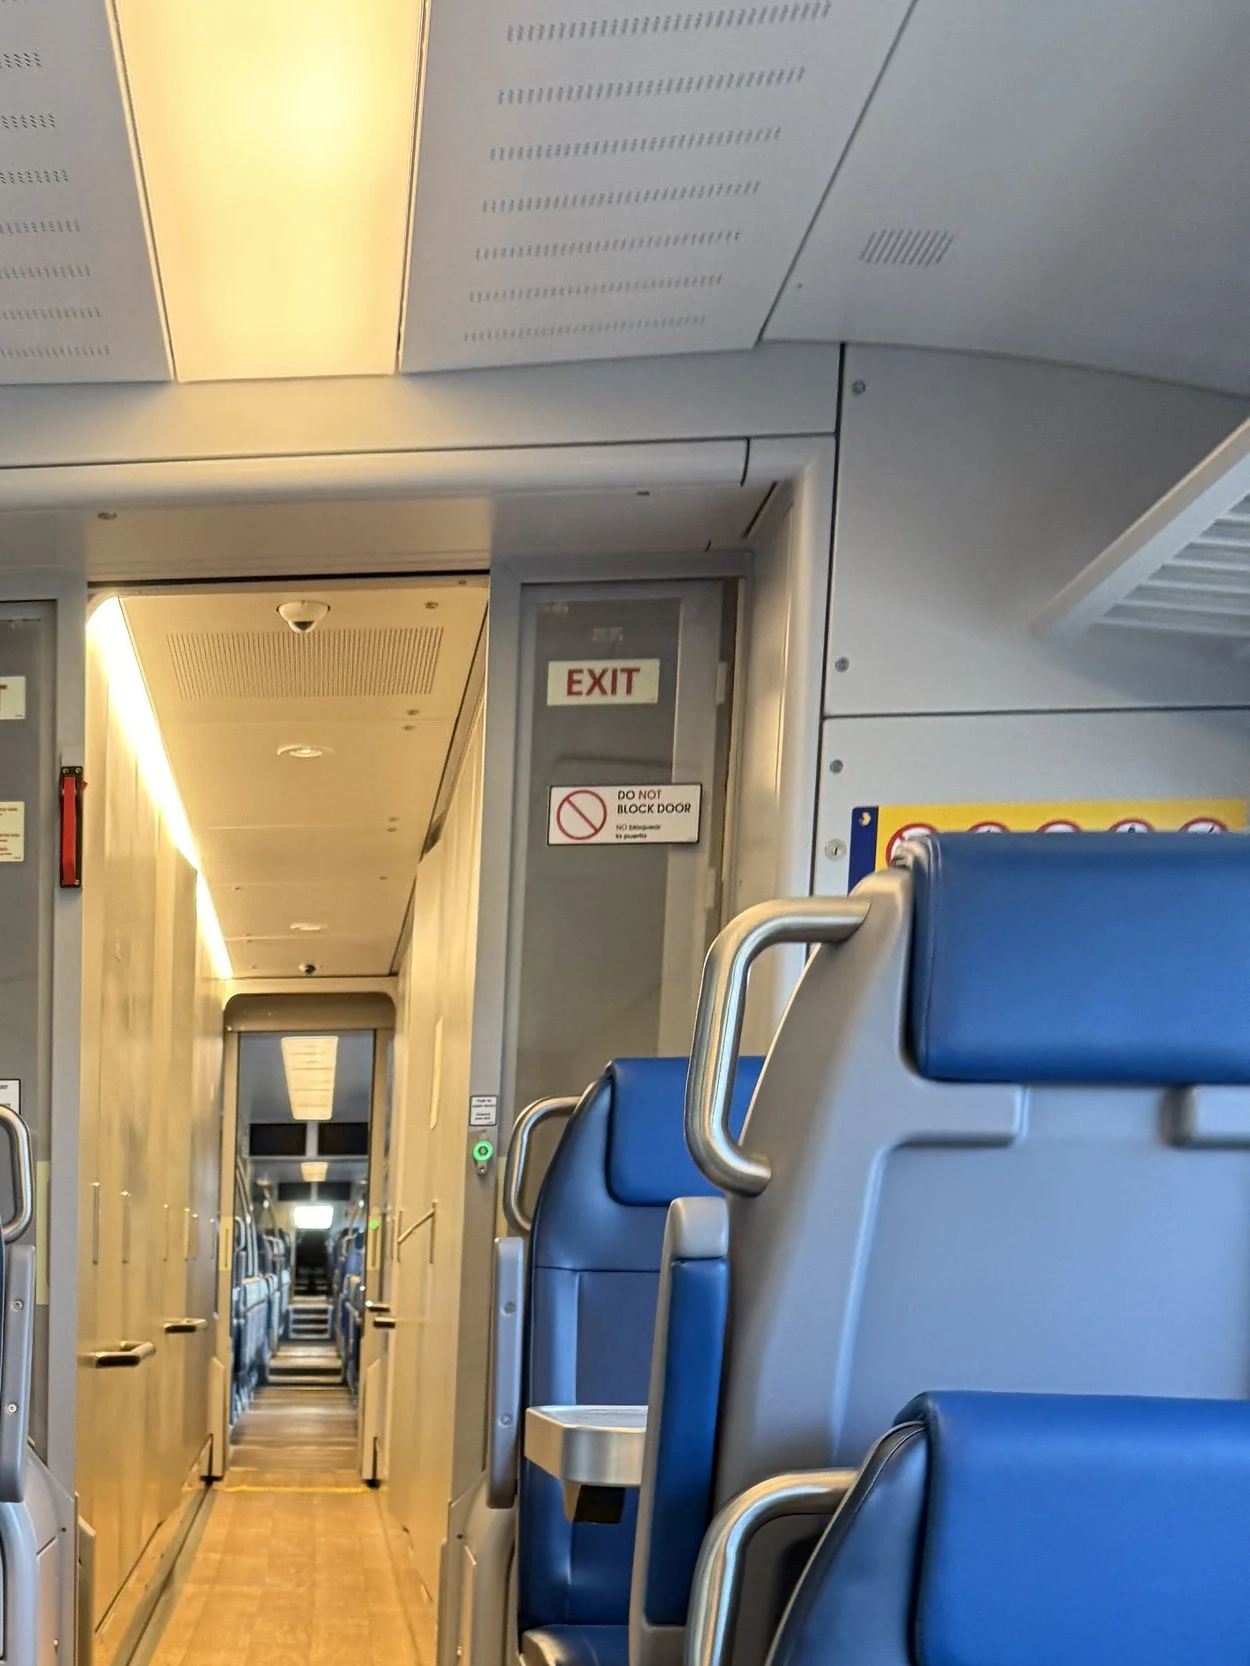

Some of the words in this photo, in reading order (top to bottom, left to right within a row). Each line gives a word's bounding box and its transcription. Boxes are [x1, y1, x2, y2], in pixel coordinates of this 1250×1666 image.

[566, 667, 641, 697] EXIT
[617, 790, 635, 801] DO
[638, 789, 662, 800] NOT
[617, 804, 654, 814] BLOCK
[657, 803, 691, 814] DOOR
